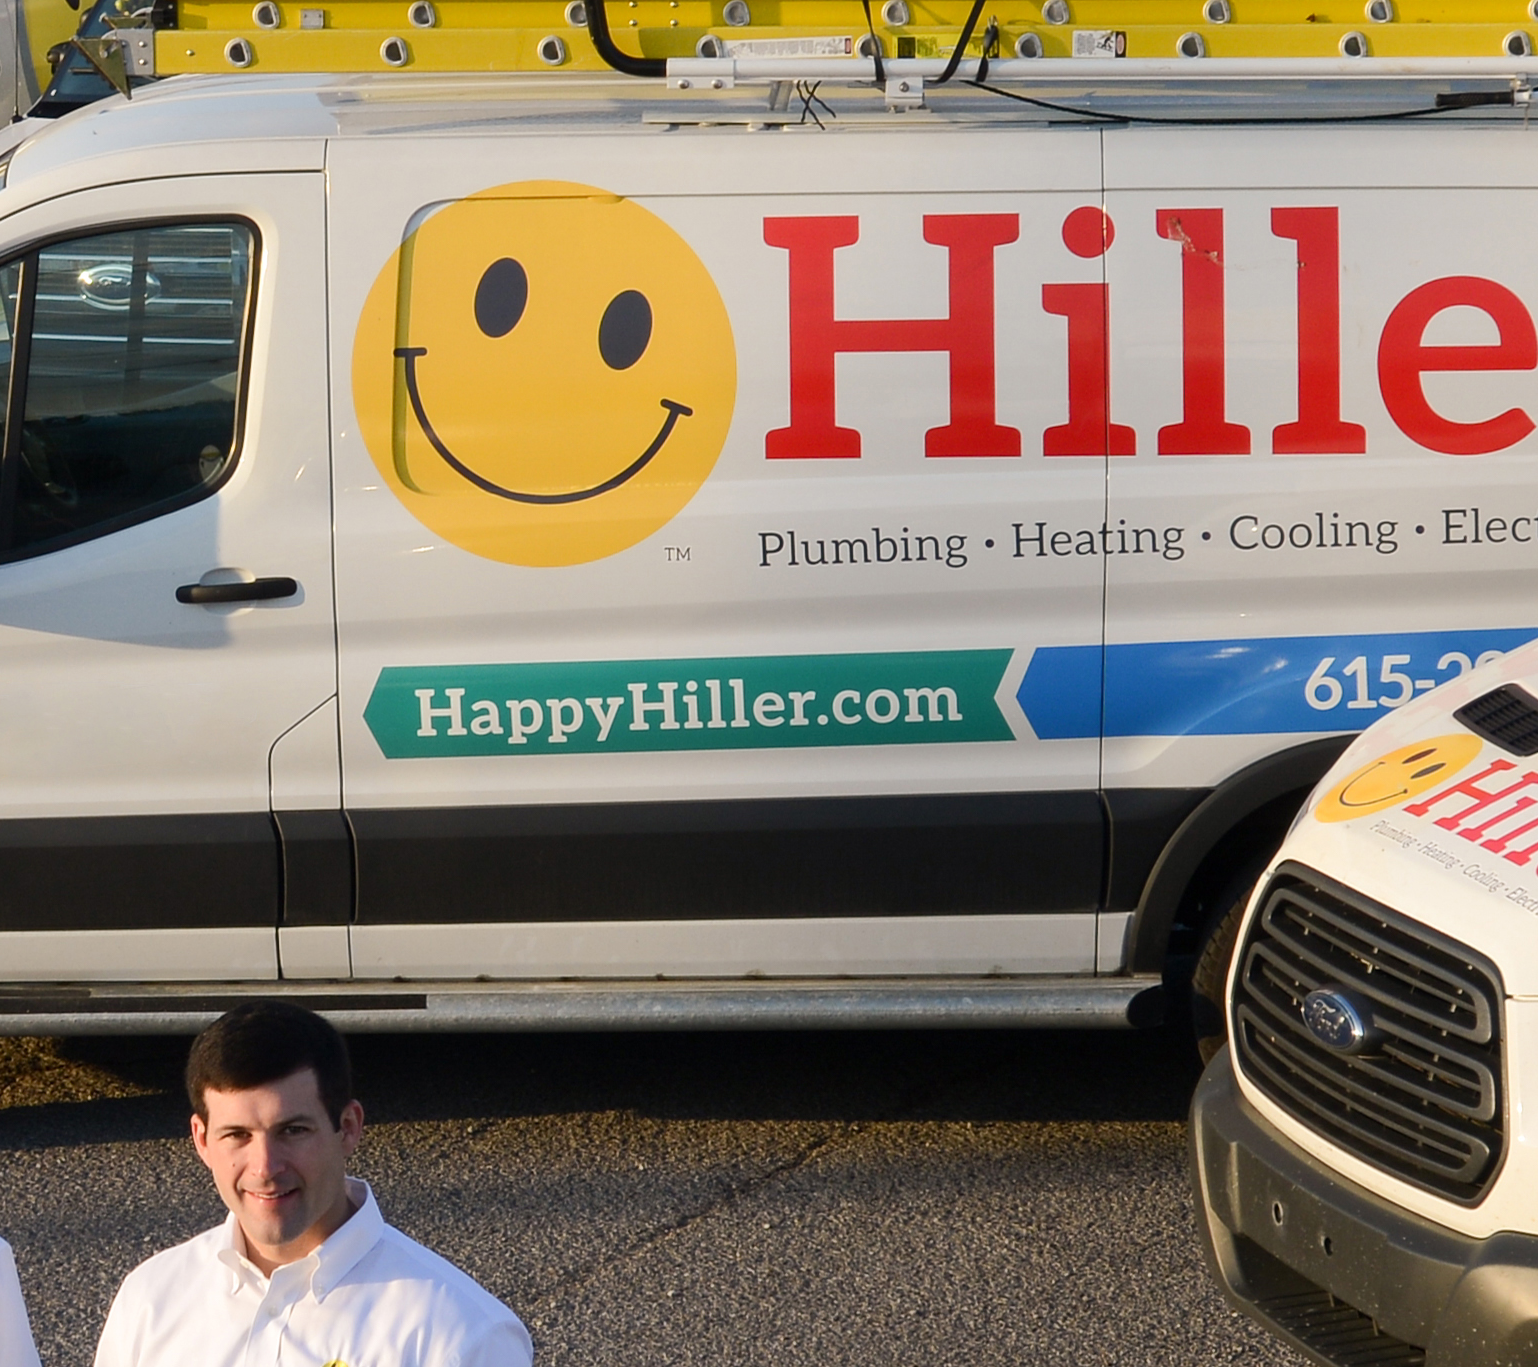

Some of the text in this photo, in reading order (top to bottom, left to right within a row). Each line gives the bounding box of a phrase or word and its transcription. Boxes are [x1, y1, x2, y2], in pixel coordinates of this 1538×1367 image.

[665, 547, 691, 562] TM
[758, 529, 968, 570] Plumbing
[1012, 517, 1186, 564] Heating
[1228, 511, 1399, 555] Cooling
[1304, 650, 1506, 711] 615-
[413, 677, 964, 746] HappyHiller.com
[1370, 819, 1418, 849] Plumbing
[1422, 840, 1461, 870] Heating
[1463, 863, 1505, 893] Cooling
